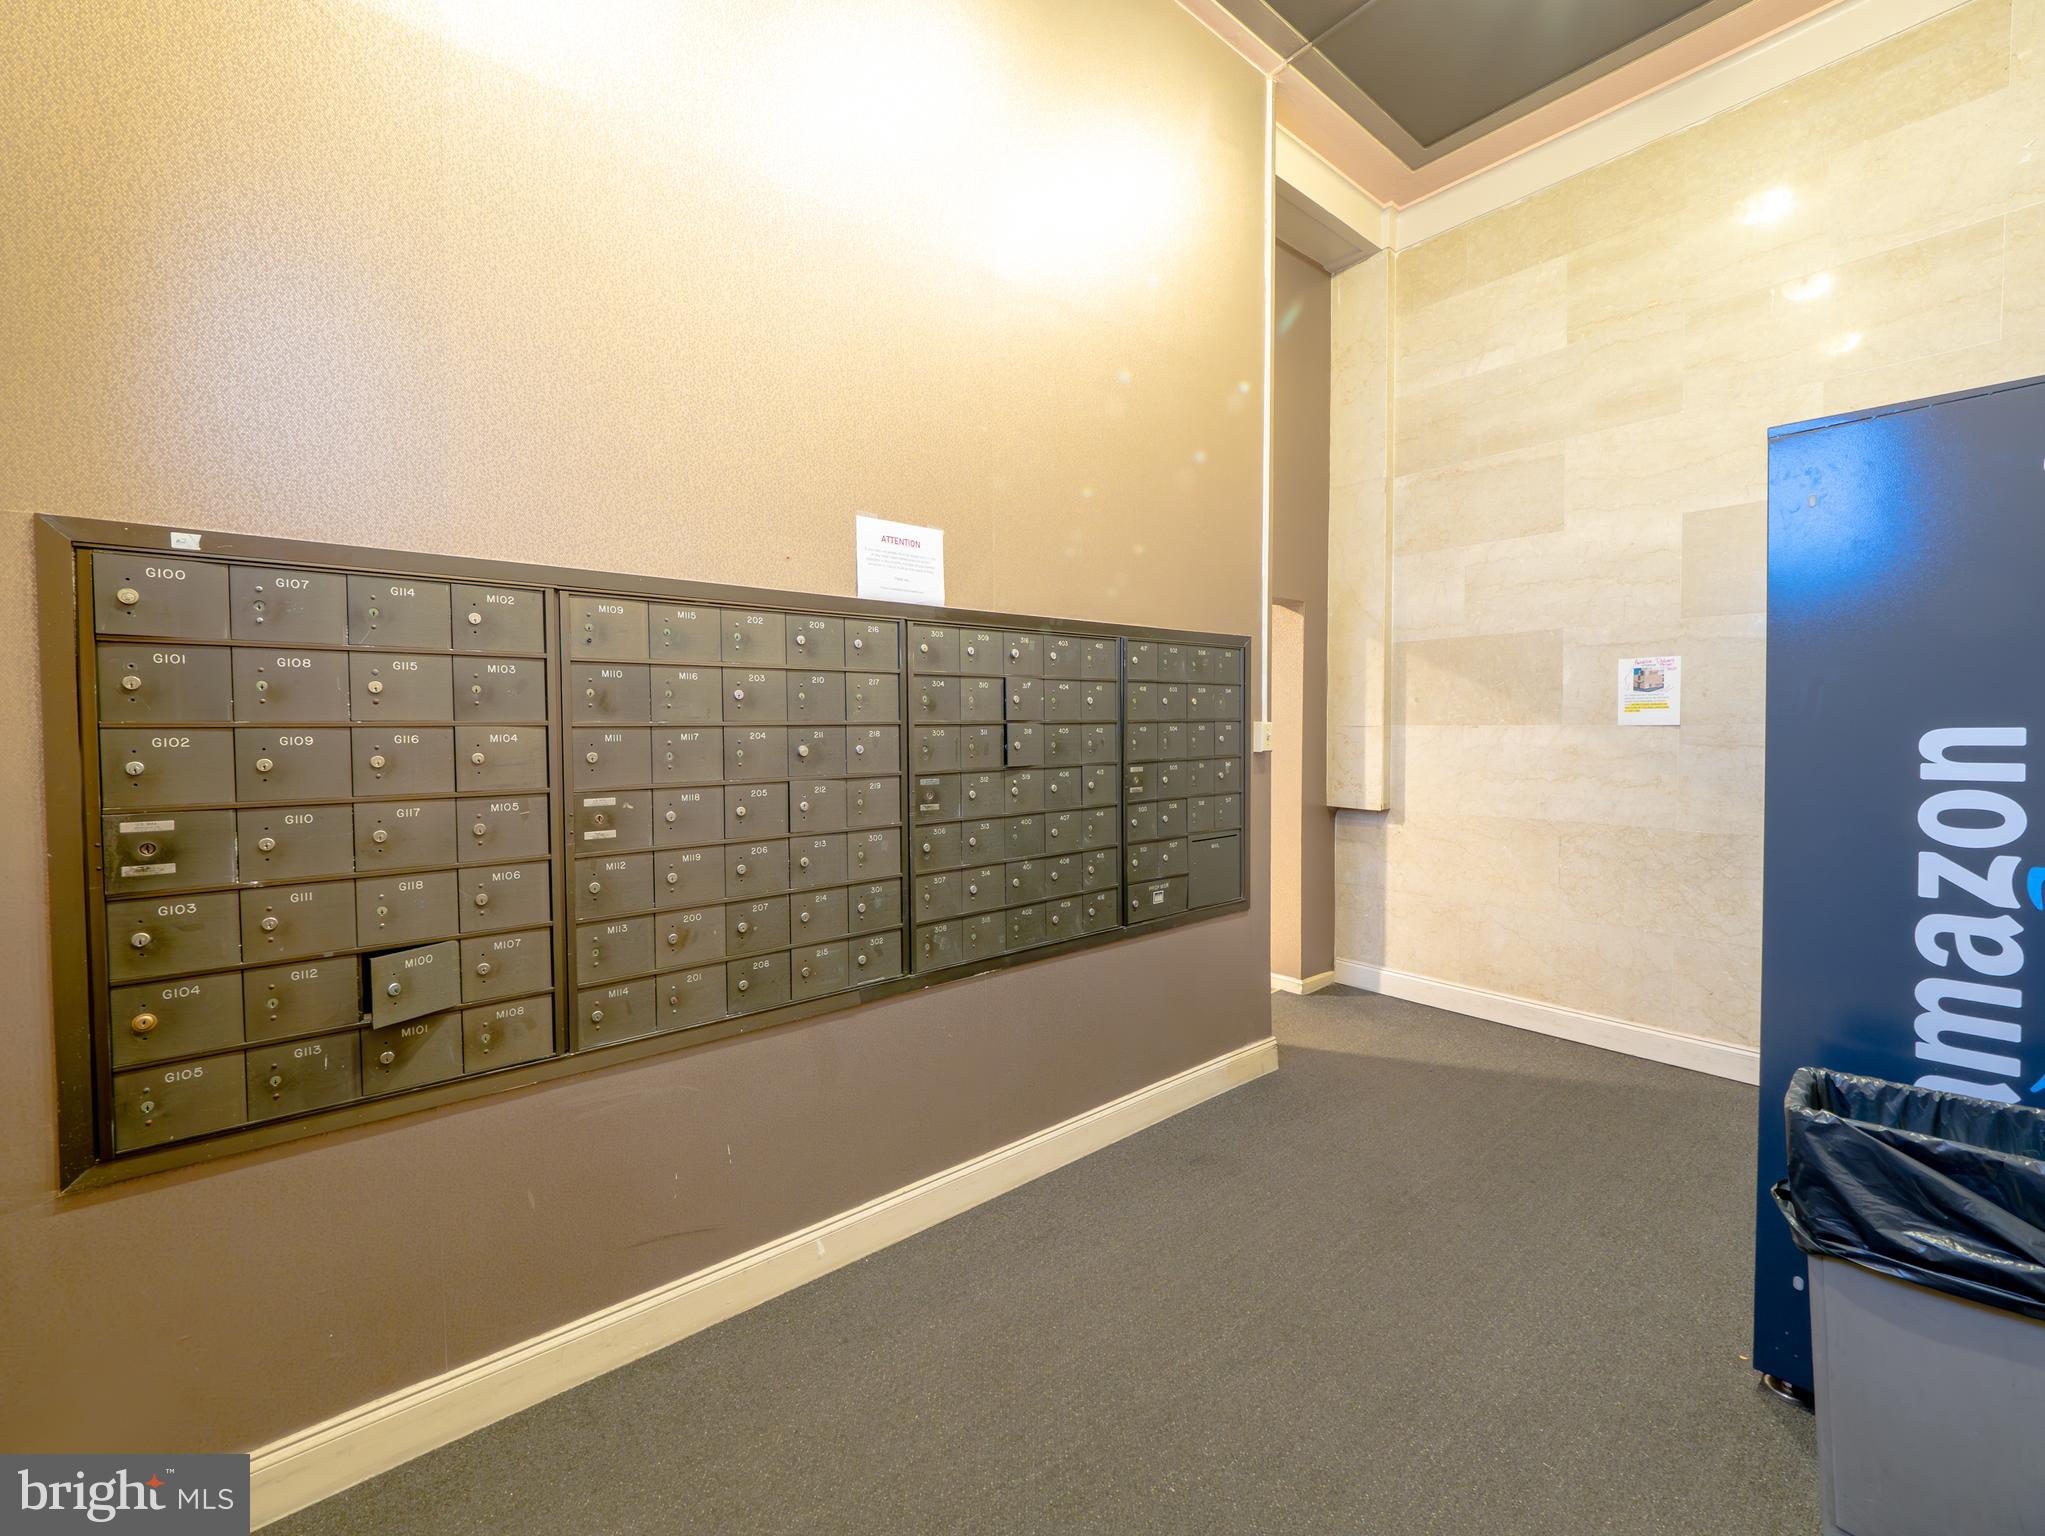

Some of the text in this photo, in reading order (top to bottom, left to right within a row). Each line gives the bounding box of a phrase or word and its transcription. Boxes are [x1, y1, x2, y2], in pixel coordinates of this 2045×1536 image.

[881, 535, 921, 549] ATTENTION
[146, 568, 185, 580] G100
[276, 578, 309, 589] G107
[391, 587, 415, 596] G114
[487, 595, 514, 605] M102
[599, 604, 624, 615] M109
[747, 616, 763, 624] 202
[809, 621, 824, 629] 209
[153, 653, 185, 664] G101
[277, 658, 311, 668] G108
[393, 661, 417, 670] G115
[488, 665, 516, 673] M103
[602, 669, 622, 678] M110
[679, 672, 698, 680] M116
[749, 673, 765, 682] 203
[152, 737, 189, 747] G102
[280, 736, 313, 745] G109
[394, 735, 419, 743] G116
[490, 734, 518, 742] M104
[605, 733, 621, 742] M111
[751, 786, 767, 797] 205
[815, 785, 826, 793] 212
[682, 793, 700, 801] M118
[397, 808, 420, 817] G117
[491, 803, 519, 812] M105
[285, 814, 313, 824] G110
[933, 827, 945, 835] 306
[751, 846, 767, 854] 206
[683, 852, 701, 862] M119
[606, 861, 625, 870] M112
[493, 871, 520, 881] M106
[399, 880, 423, 891] G118
[290, 892, 312, 902] G111
[158, 903, 196, 916] G103
[752, 903, 768, 912] 207
[683, 912, 702, 922] 200
[607, 924, 628, 935] M113
[934, 925, 947, 933] 308
[494, 939, 521, 950] M107
[870, 936, 883, 946] 302
[816, 948, 828, 957] 215
[405, 954, 433, 968] M100
[753, 960, 769, 969] 208
[291, 969, 318, 980] G112
[687, 973, 702, 983] 201
[162, 985, 200, 999] G104
[609, 987, 629, 998] M114
[497, 1006, 524, 1019] M108
[402, 1024, 427, 1037] M101
[294, 1045, 321, 1058] G113
[165, 1067, 203, 1083] G105
